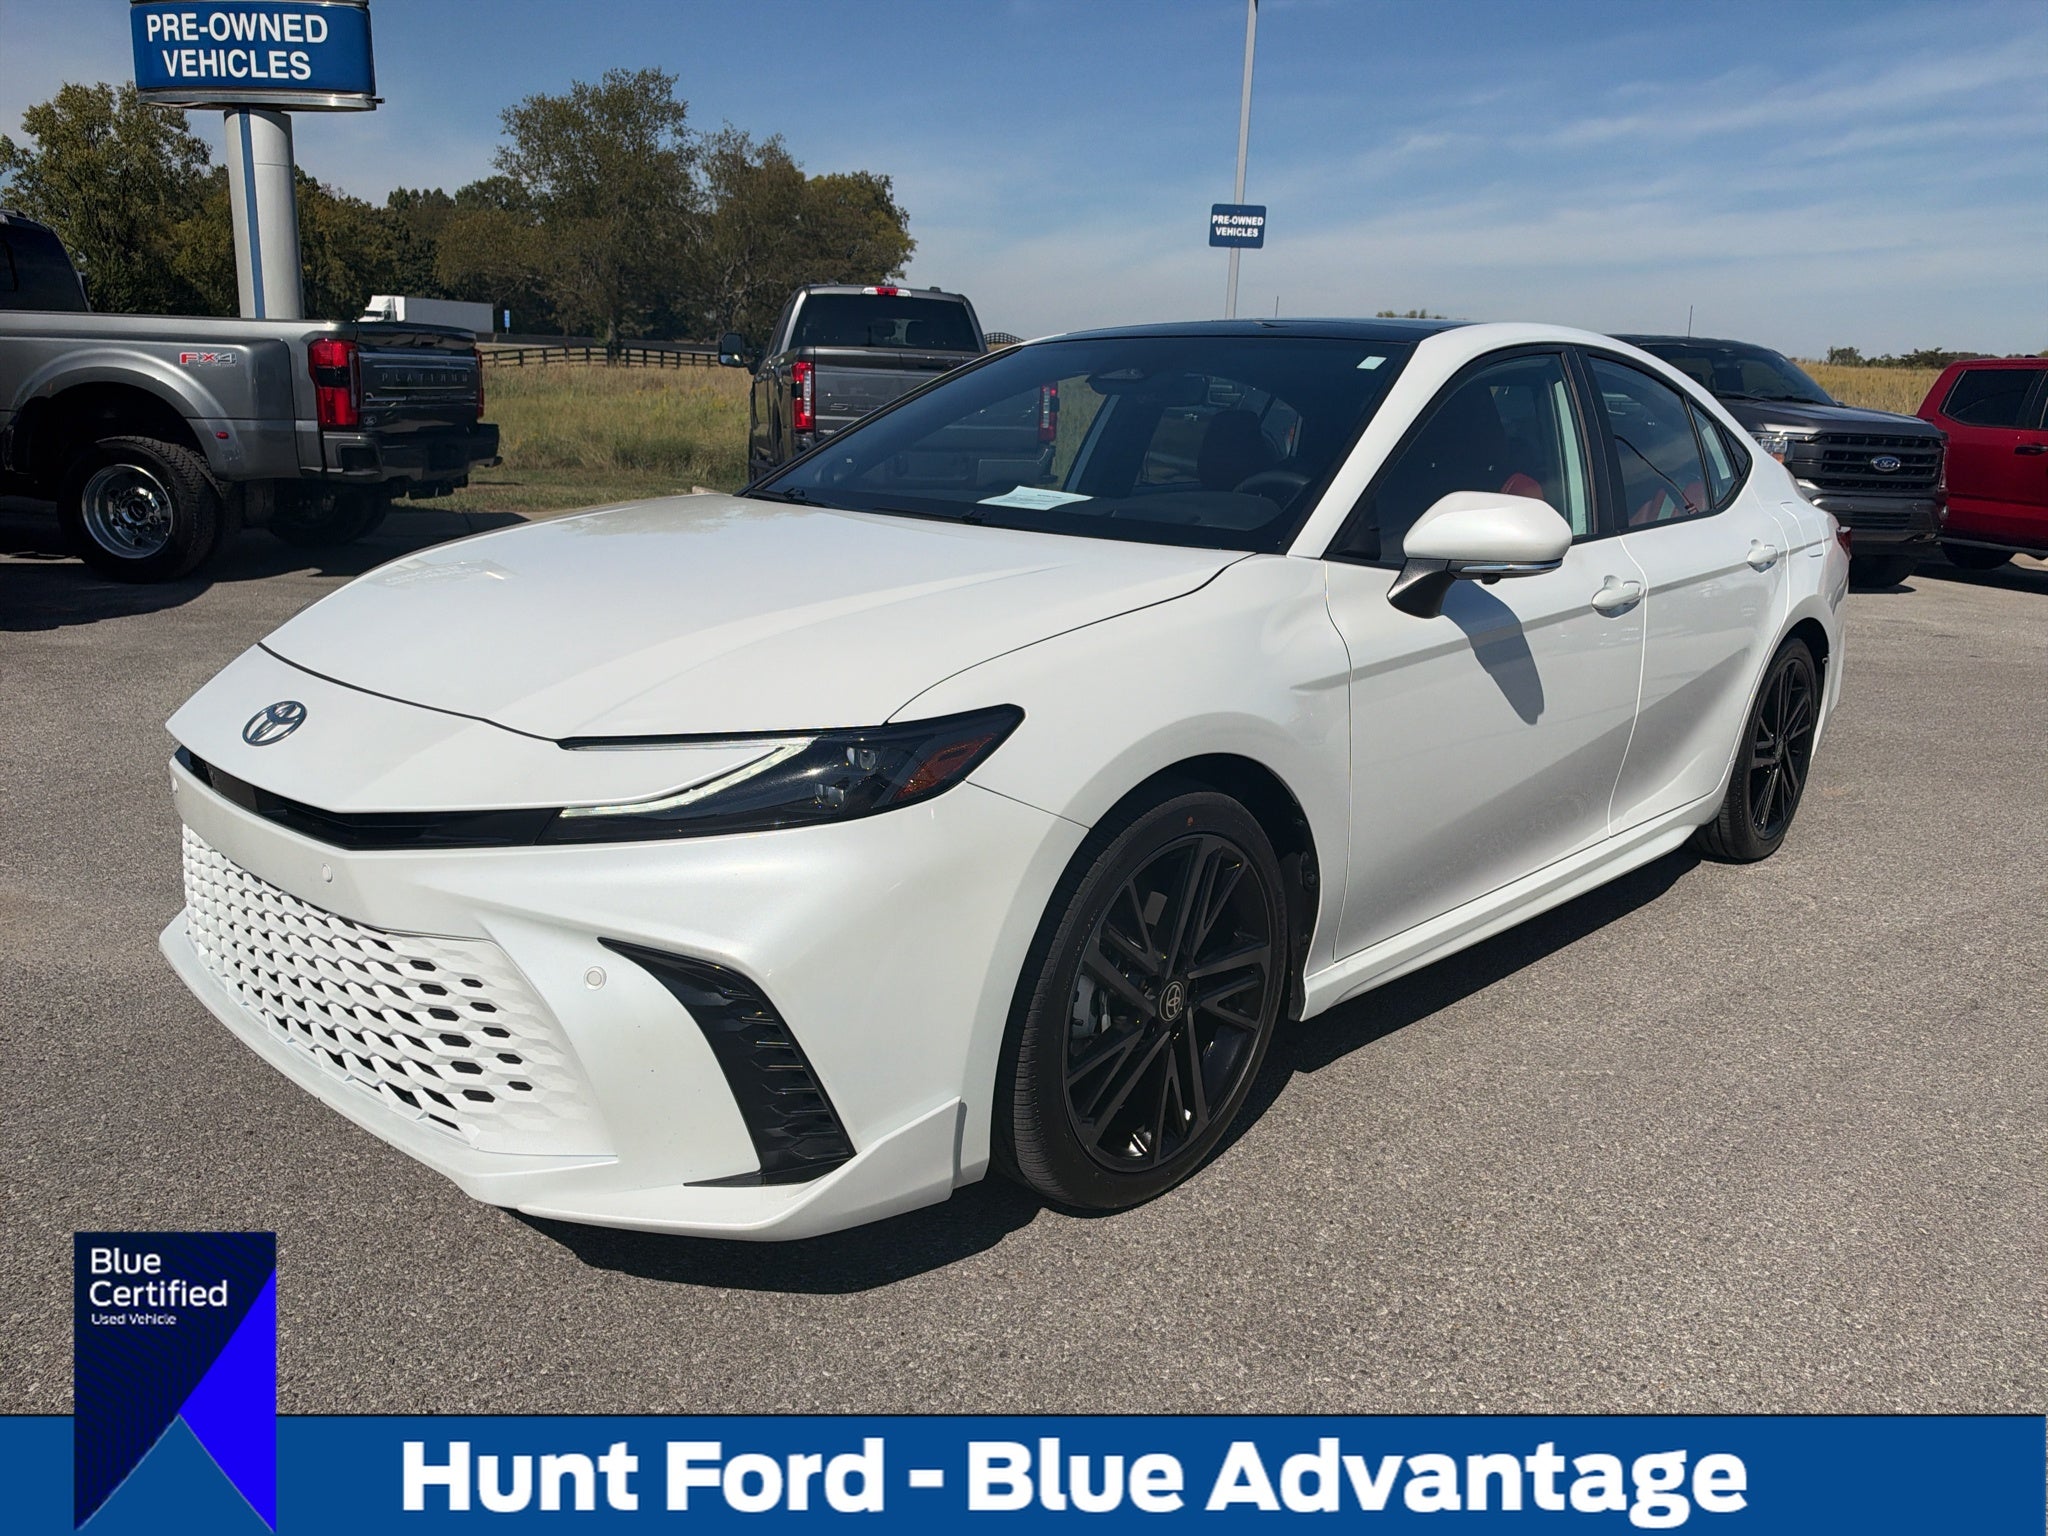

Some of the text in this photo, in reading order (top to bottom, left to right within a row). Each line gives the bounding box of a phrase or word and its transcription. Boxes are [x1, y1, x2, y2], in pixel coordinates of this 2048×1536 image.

[146, 12, 328, 43] PRE-OWNED
[162, 49, 311, 80] VEHICLES
[1212, 215, 1264, 226] PRE-OWNED
[1215, 227, 1259, 238] VEHICLES
[179, 352, 237, 365] FX4
